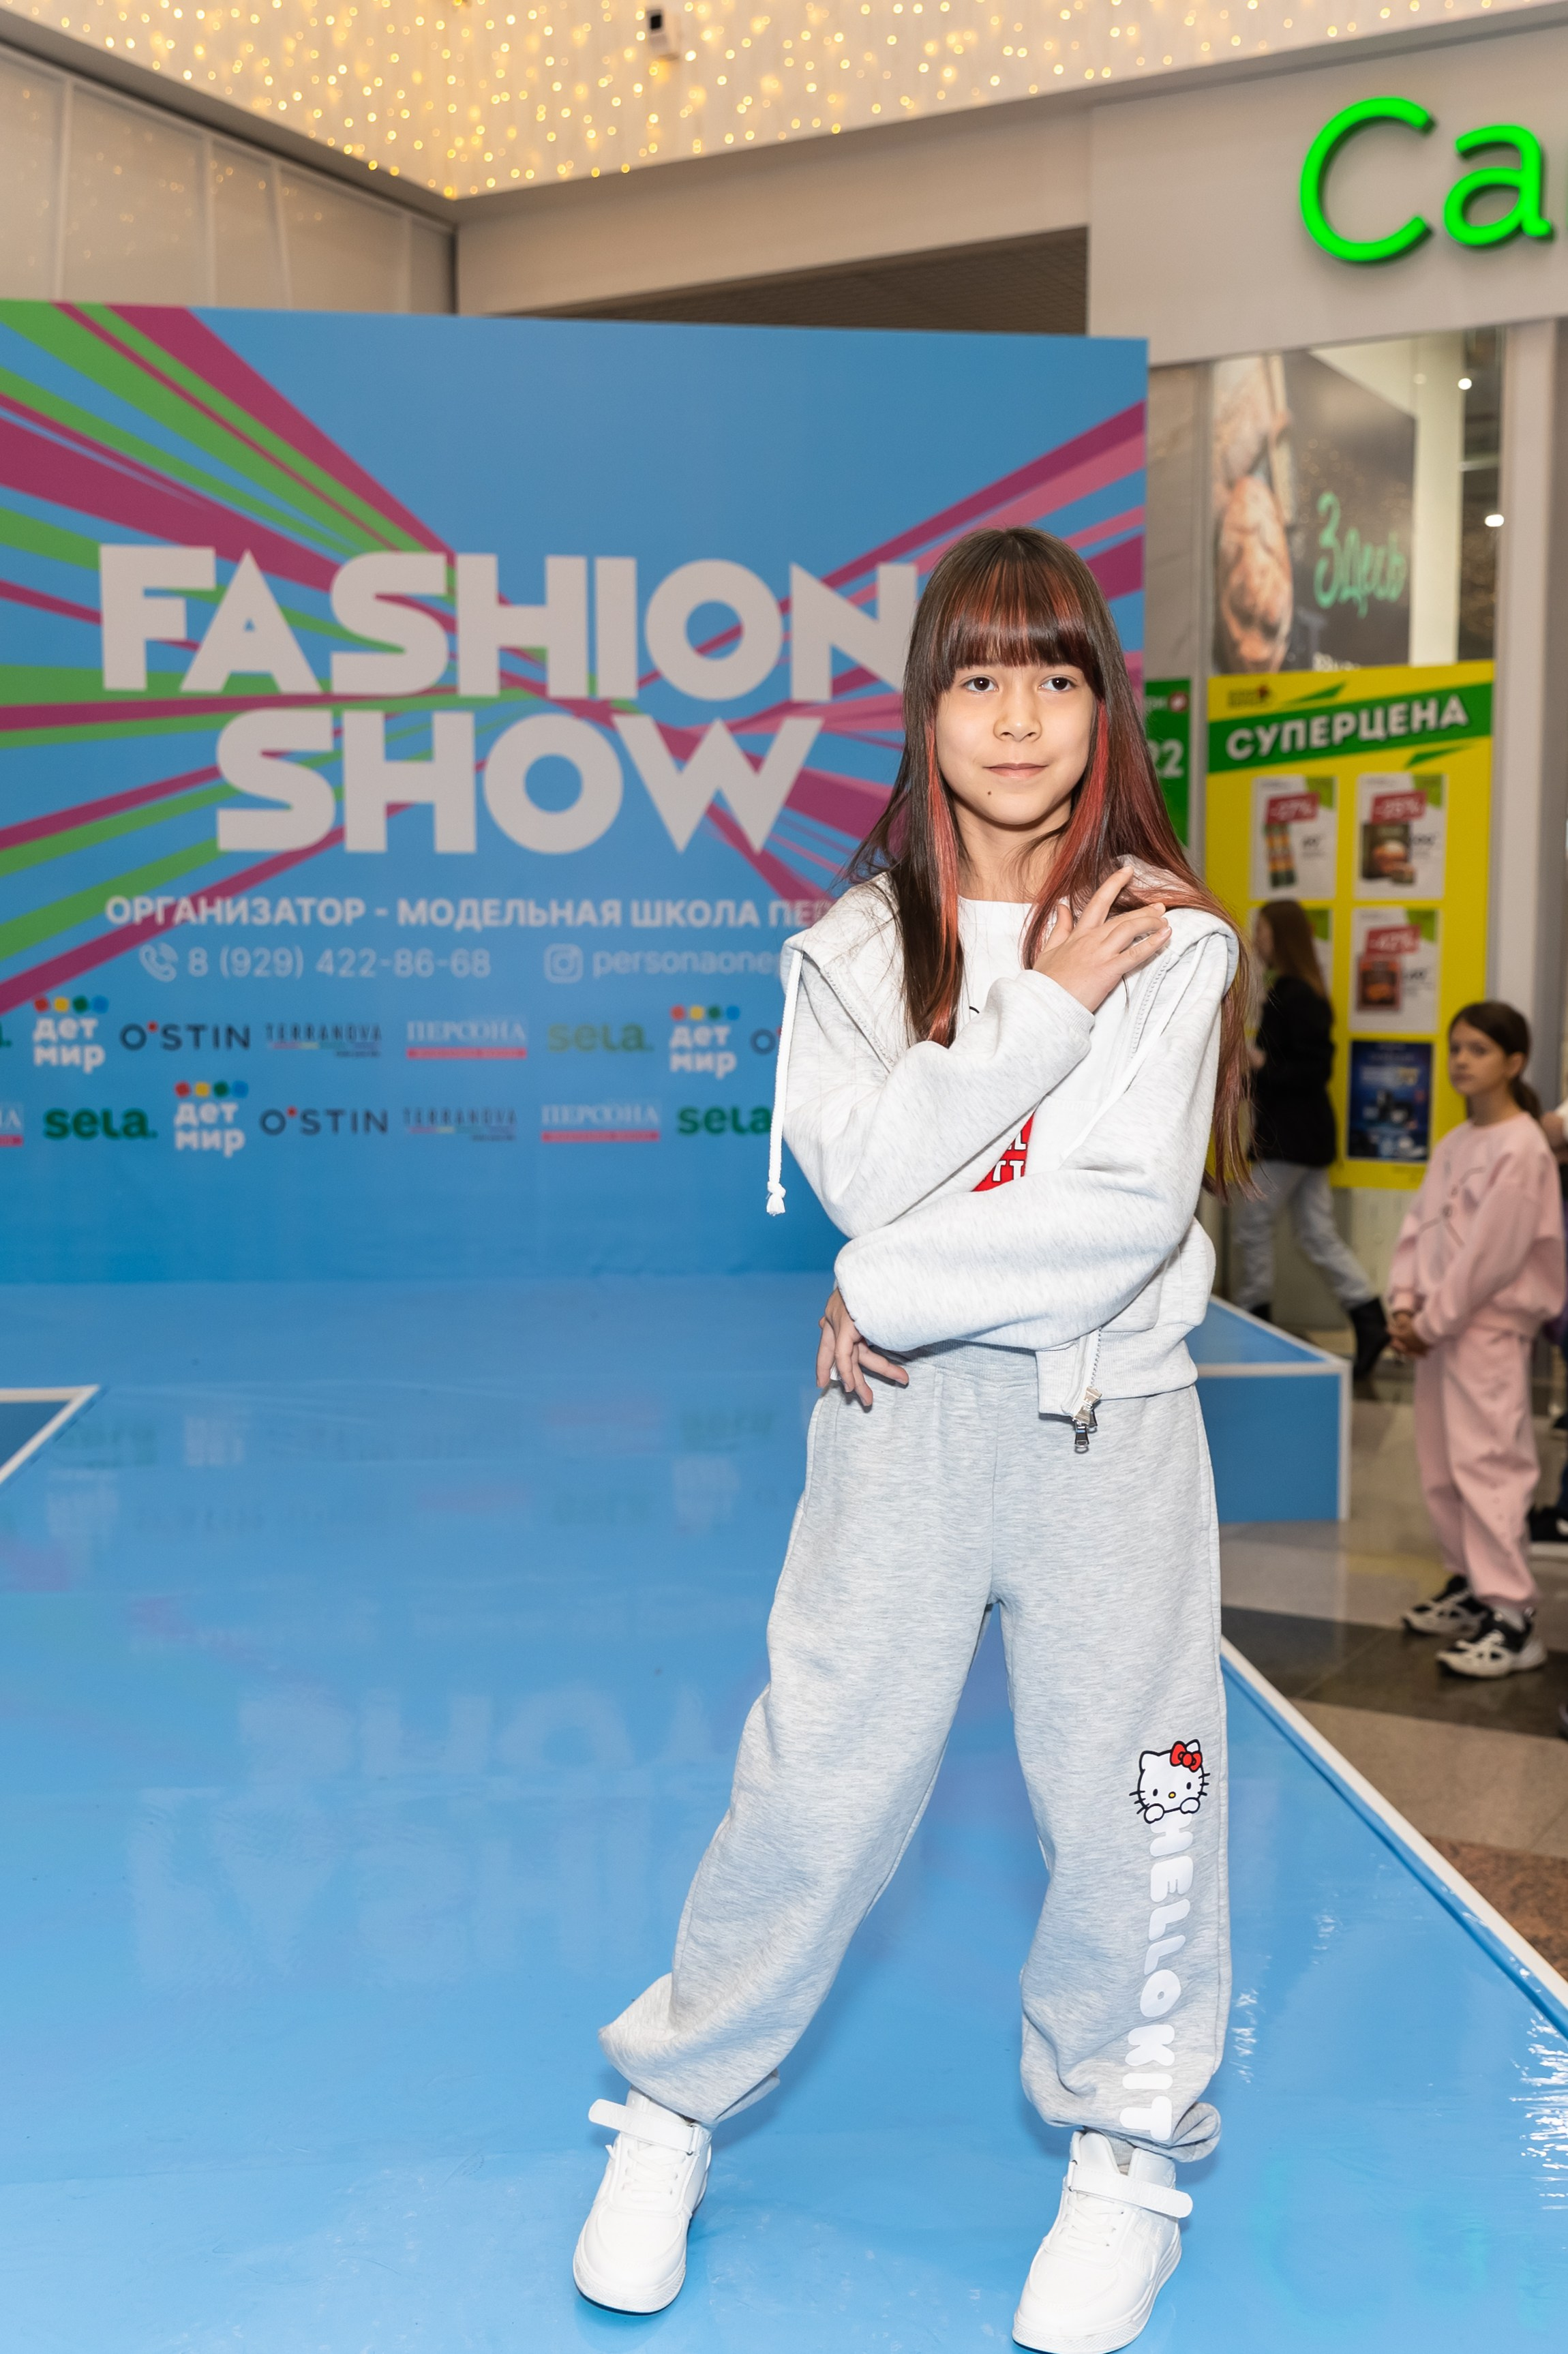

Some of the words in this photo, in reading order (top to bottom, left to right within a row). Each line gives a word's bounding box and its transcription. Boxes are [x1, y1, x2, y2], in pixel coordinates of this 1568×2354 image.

[100, 545, 916, 701] FASHION
[1226, 694, 1469, 761] СУПЕРЦЕНА
[216, 708, 823, 855] SHOW
[105, 896, 366, 926] ОРГАНИЗАТОР
[397, 898, 622, 932] МОДЕЛЬНАЯ
[630, 899, 760, 928] ШКОЛА
[187, 948, 209, 978] 8
[219, 945, 305, 980] (929)
[316, 947, 492, 979] 422-86-68
[592, 949, 779, 979] personaone
[33, 1018, 99, 1042] дет
[33, 1044, 106, 1075] мир
[669, 1051, 738, 1081] мир
[174, 1102, 238, 1127] дет
[174, 1129, 246, 1158] мир
[1139, 1811, 1194, 2018] HELLO
[1119, 2023, 1175, 2141] KIT
